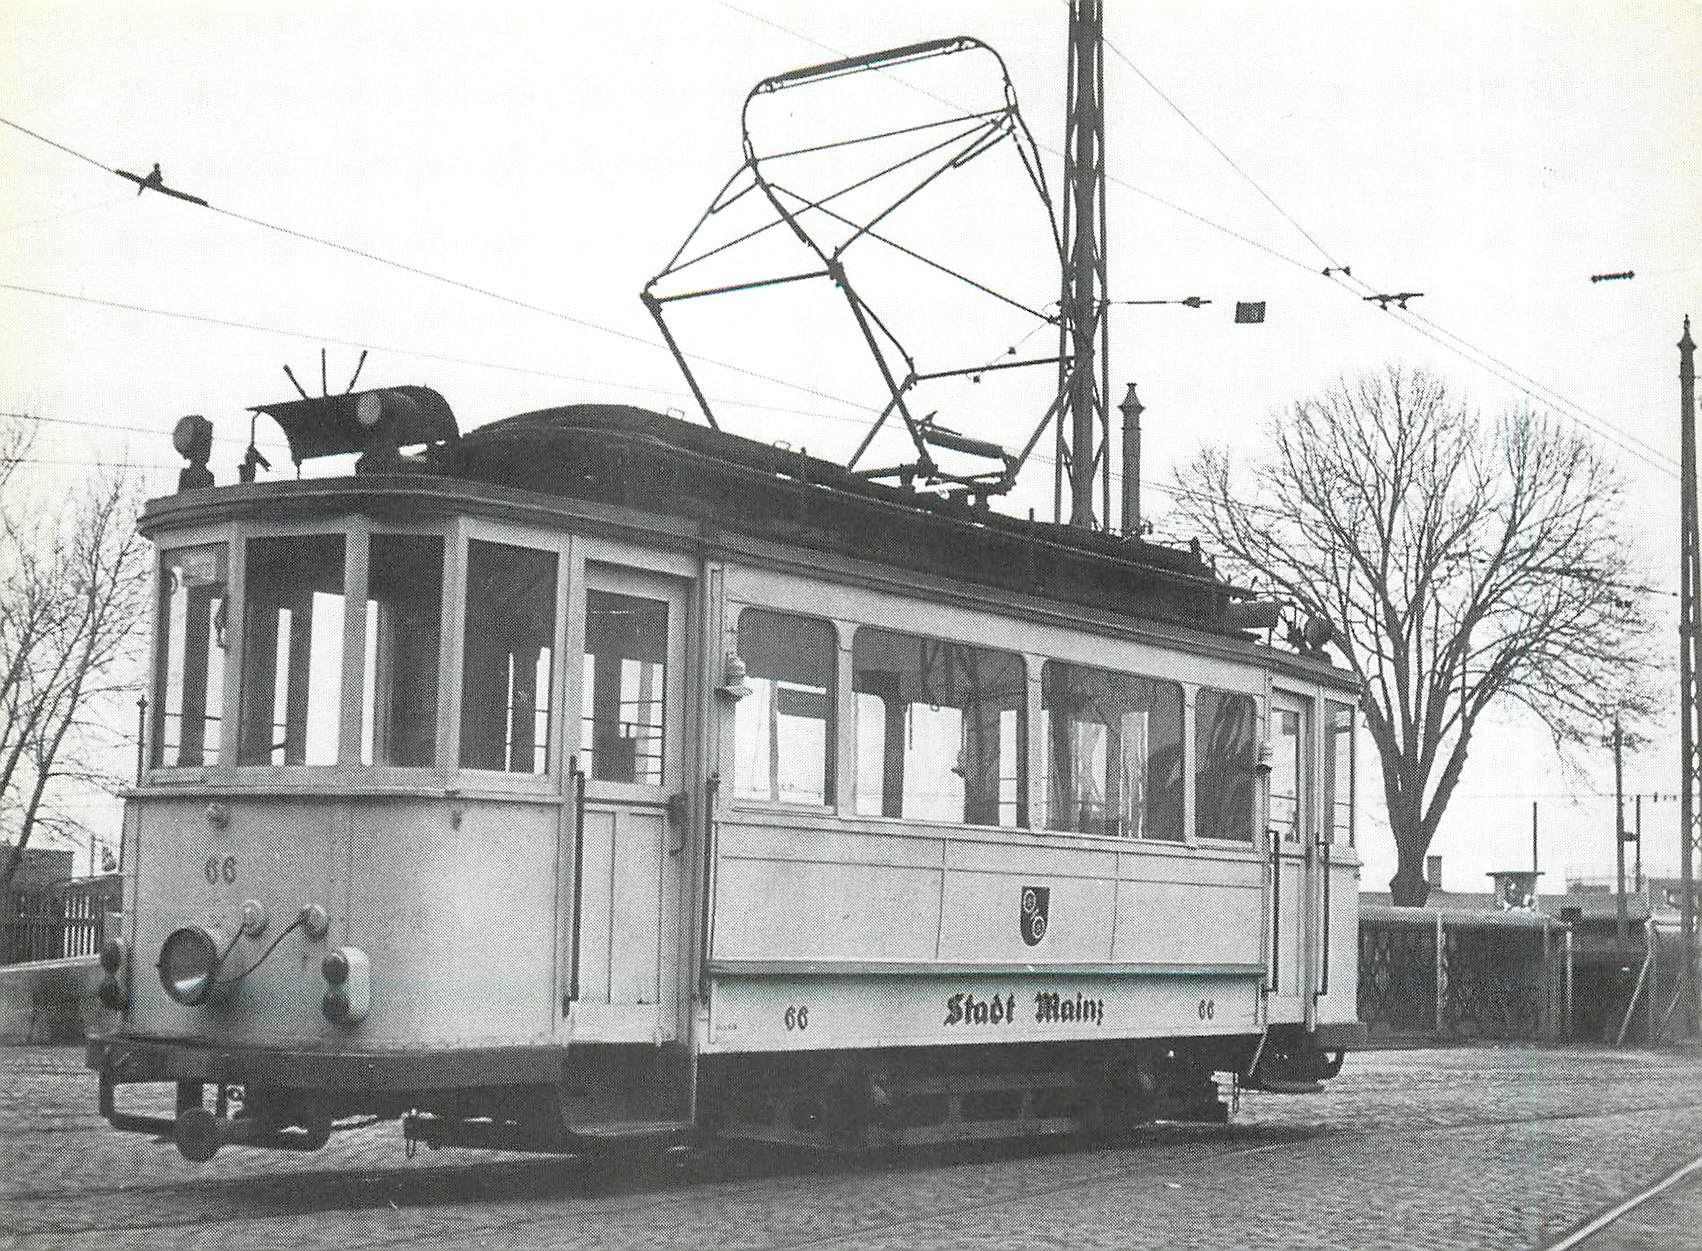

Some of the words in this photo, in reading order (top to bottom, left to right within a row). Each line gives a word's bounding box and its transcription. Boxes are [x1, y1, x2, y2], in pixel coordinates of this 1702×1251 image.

[204, 856, 237, 886] 66
[784, 1005, 809, 1031] 66
[943, 992, 1016, 1027] Stadt
[1034, 991, 1104, 1026] Mainz
[1198, 999, 1215, 1020] 66
